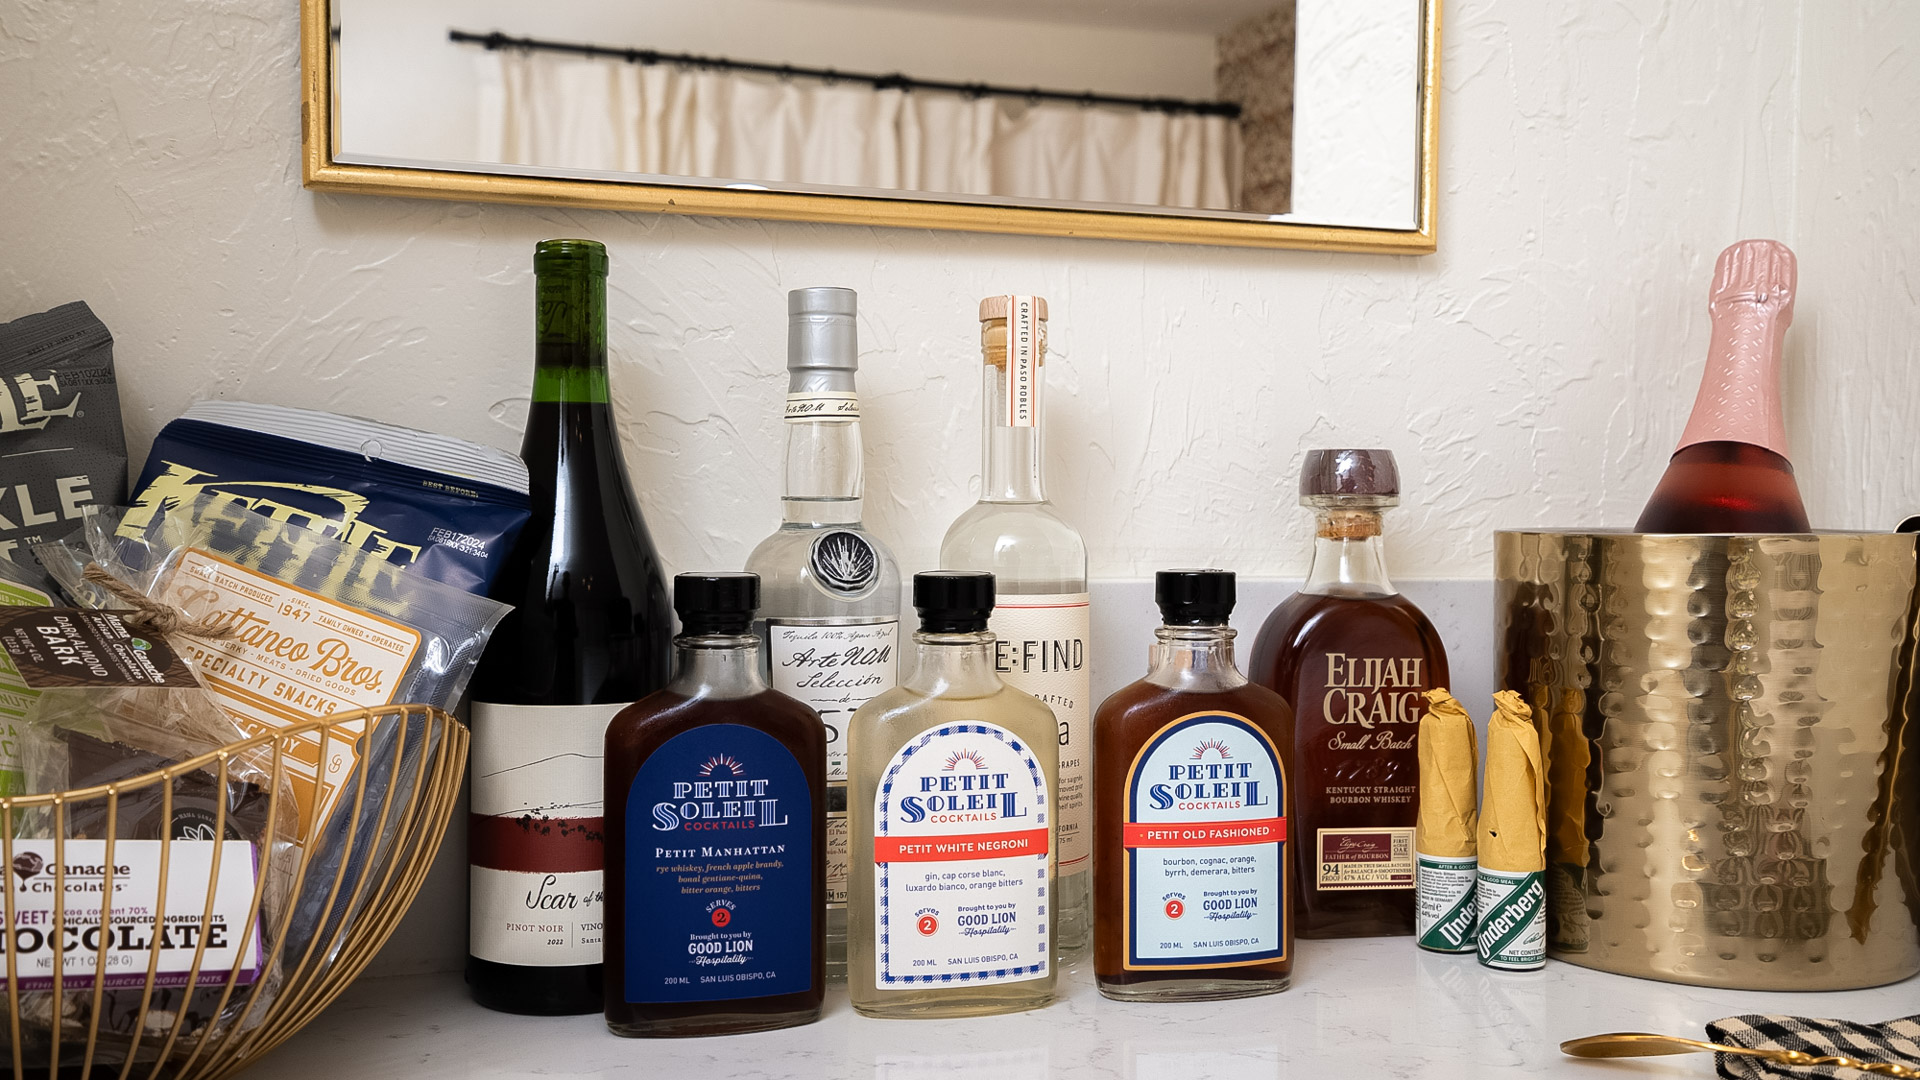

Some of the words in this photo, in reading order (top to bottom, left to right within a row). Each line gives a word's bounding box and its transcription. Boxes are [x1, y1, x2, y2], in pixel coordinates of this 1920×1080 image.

[1020, 302, 1029, 343] CRAFTED
[1020, 346, 1028, 356] IN
[1020, 358, 1028, 382] PASO
[1019, 385, 1028, 420] ROBLES
[422, 480, 443, 490] BEST
[430, 527, 486, 550] FEB172024
[214, 576, 238, 590] BATCH
[240, 585, 274, 603] PRODUCED
[277, 602, 311, 623] 1947
[177, 585, 310, 662] Cattaneo
[308, 638, 384, 694] Bros.
[318, 615, 342, 629] FAMILY
[342, 624, 364, 637] OWNED
[371, 635, 404, 652] OPERATED
[782, 630, 818, 642] Tequila
[36, 626, 84, 665] BARK
[53, 615, 82, 639] DARK
[71, 639, 108, 677] ALMOND
[112, 643, 144, 680] Chocolates
[133, 649, 165, 684] Ganache
[220, 641, 248, 656] JERKY
[256, 654, 287, 670] MEATS
[295, 669, 322, 684] DRIED
[325, 680, 357, 696] GOODS
[796, 670, 883, 688] Selección
[273, 682, 338, 714] SNACKS
[1323, 687, 1420, 729] CRAIG
[1328, 730, 1372, 750] Small
[1369, 730, 1416, 750] Batch
[1168, 762, 1252, 780] PETIT
[673, 779, 769, 799] PETIT
[920, 773, 1009, 792] PETIT
[1325, 786, 1372, 794] KENTUCKY
[1373, 785, 1416, 793] STRAIGHT
[1149, 780, 1268, 810] SOLEIL
[1330, 796, 1371, 804] BOURBON
[1373, 795, 1412, 803] WHISKEY
[900, 791, 1027, 823] SOLEIL
[1178, 800, 1240, 810] COCKTAILS
[652, 799, 788, 831] SOLEIL
[930, 812, 997, 823] COCKTAILS
[684, 820, 755, 831] COCKTAILS
[1147, 830, 1180, 840] PETIT
[1182, 830, 1206, 840] OLD
[1209, 826, 1270, 838] FASHIONED
[899, 844, 933, 854] PETIT
[935, 842, 974, 853] WHITE
[977, 838, 1028, 851] NEGRONI
[655, 865, 669, 874] rye
[671, 863, 704, 874] whiskey,
[705, 863, 731, 873] french
[733, 861, 754, 871] apple
[755, 859, 784, 870] brandy,
[1162, 858, 1198, 866] bourbon,
[1199, 857, 1229, 867] cognac,
[1229, 855, 1257, 864] orange,
[924, 871, 940, 882] gin,
[941, 873, 956, 881] cap
[957, 871, 981, 880] corse
[982, 869, 1006, 878] blanc,
[1164, 868, 1189, 878] byrrh,
[1190, 867, 1230, 876] demerara,
[1231, 865, 1255, 874] bitters
[1322, 863, 1340, 875] 94
[678, 875, 700, 883] bonal
[905, 883, 937, 892] luxardo
[938, 882, 968, 891] bianco,
[968, 880, 997, 890] orange
[998, 878, 1024, 887] bitters
[525, 874, 579, 910] Scar
[583, 890, 594, 907] of
[681, 886, 703, 894] bitter
[704, 885, 734, 895] orange,
[735, 883, 761, 892] bitters
[1162, 891, 1186, 902] serves
[129, 907, 149, 915] 70%
[705, 899, 736, 913] SERVES
[957, 904, 986, 912] Brought
[995, 903, 1007, 911] you
[1007, 901, 1016, 910] by
[1170, 903, 1179, 915] 2
[1203, 899, 1232, 911] GOOD
[1235, 897, 1258, 909] LION
[716, 912, 727, 923] 2
[914, 907, 940, 918] serves
[957, 914, 988, 926] GOOD
[991, 911, 1016, 924] LION
[1209, 910, 1253, 922] Hospitality
[1478, 879, 1544, 959] Underberg
[506, 923, 535, 932] PINOT
[923, 919, 932, 931] 2
[964, 925, 1011, 937] Hospitality
[688, 942, 722, 955] GOOD
[725, 939, 753, 953] LION
[1208, 940, 1224, 948] LUIS
[1225, 938, 1250, 947] OBISPO,
[695, 954, 747, 967] Hospitality
[912, 959, 925, 967] 200
[926, 958, 938, 966] ML
[947, 957, 962, 965] SAN
[964, 956, 980, 964] LUIS
[981, 954, 1008, 963] OBISPO,
[664, 977, 678, 985] 200
[700, 975, 716, 984] SAN
[717, 974, 735, 982] LUIS
[735, 972, 765, 981] OBISPO,
[765, 971, 776, 979] CA
